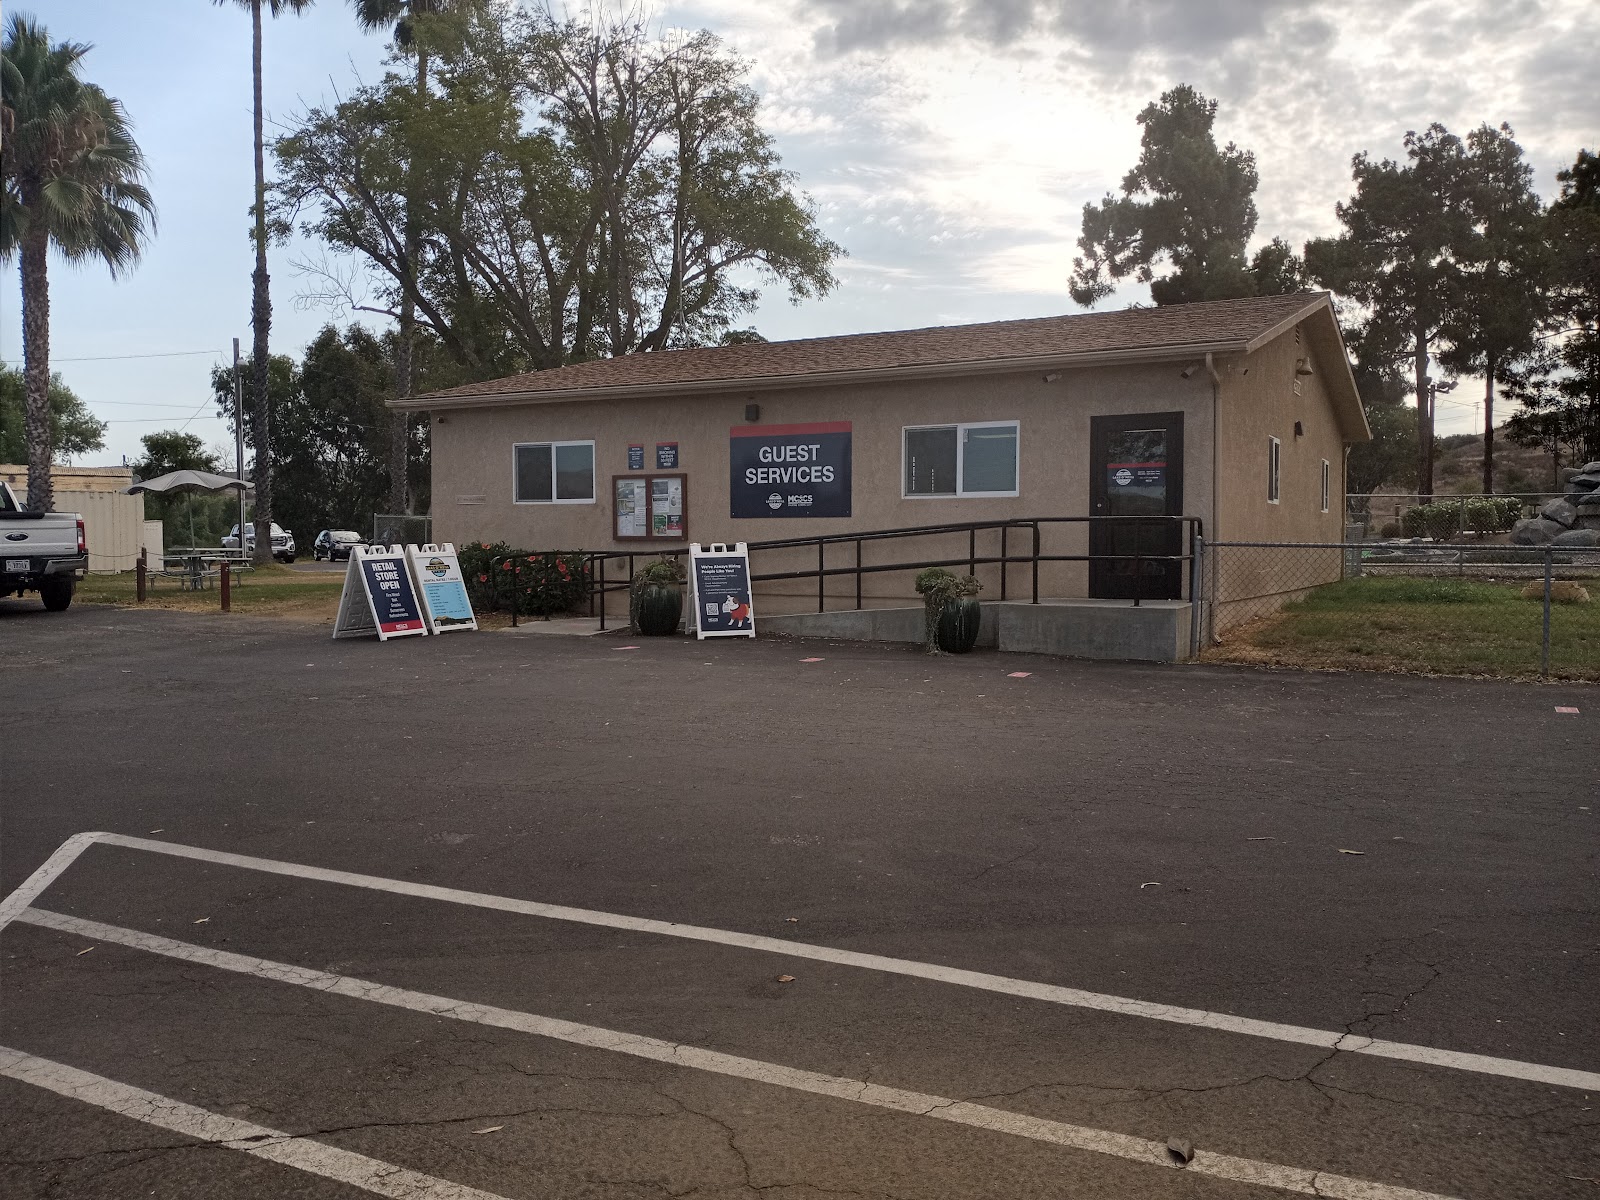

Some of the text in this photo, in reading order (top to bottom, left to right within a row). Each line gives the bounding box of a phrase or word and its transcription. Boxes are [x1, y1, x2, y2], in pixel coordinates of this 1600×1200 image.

[759, 444, 820, 462] GUEST
[745, 466, 834, 484] SERVICES
[372, 562, 397, 571] RETAIL
[375, 571, 399, 580] STORE
[380, 581, 400, 590] OPEN
